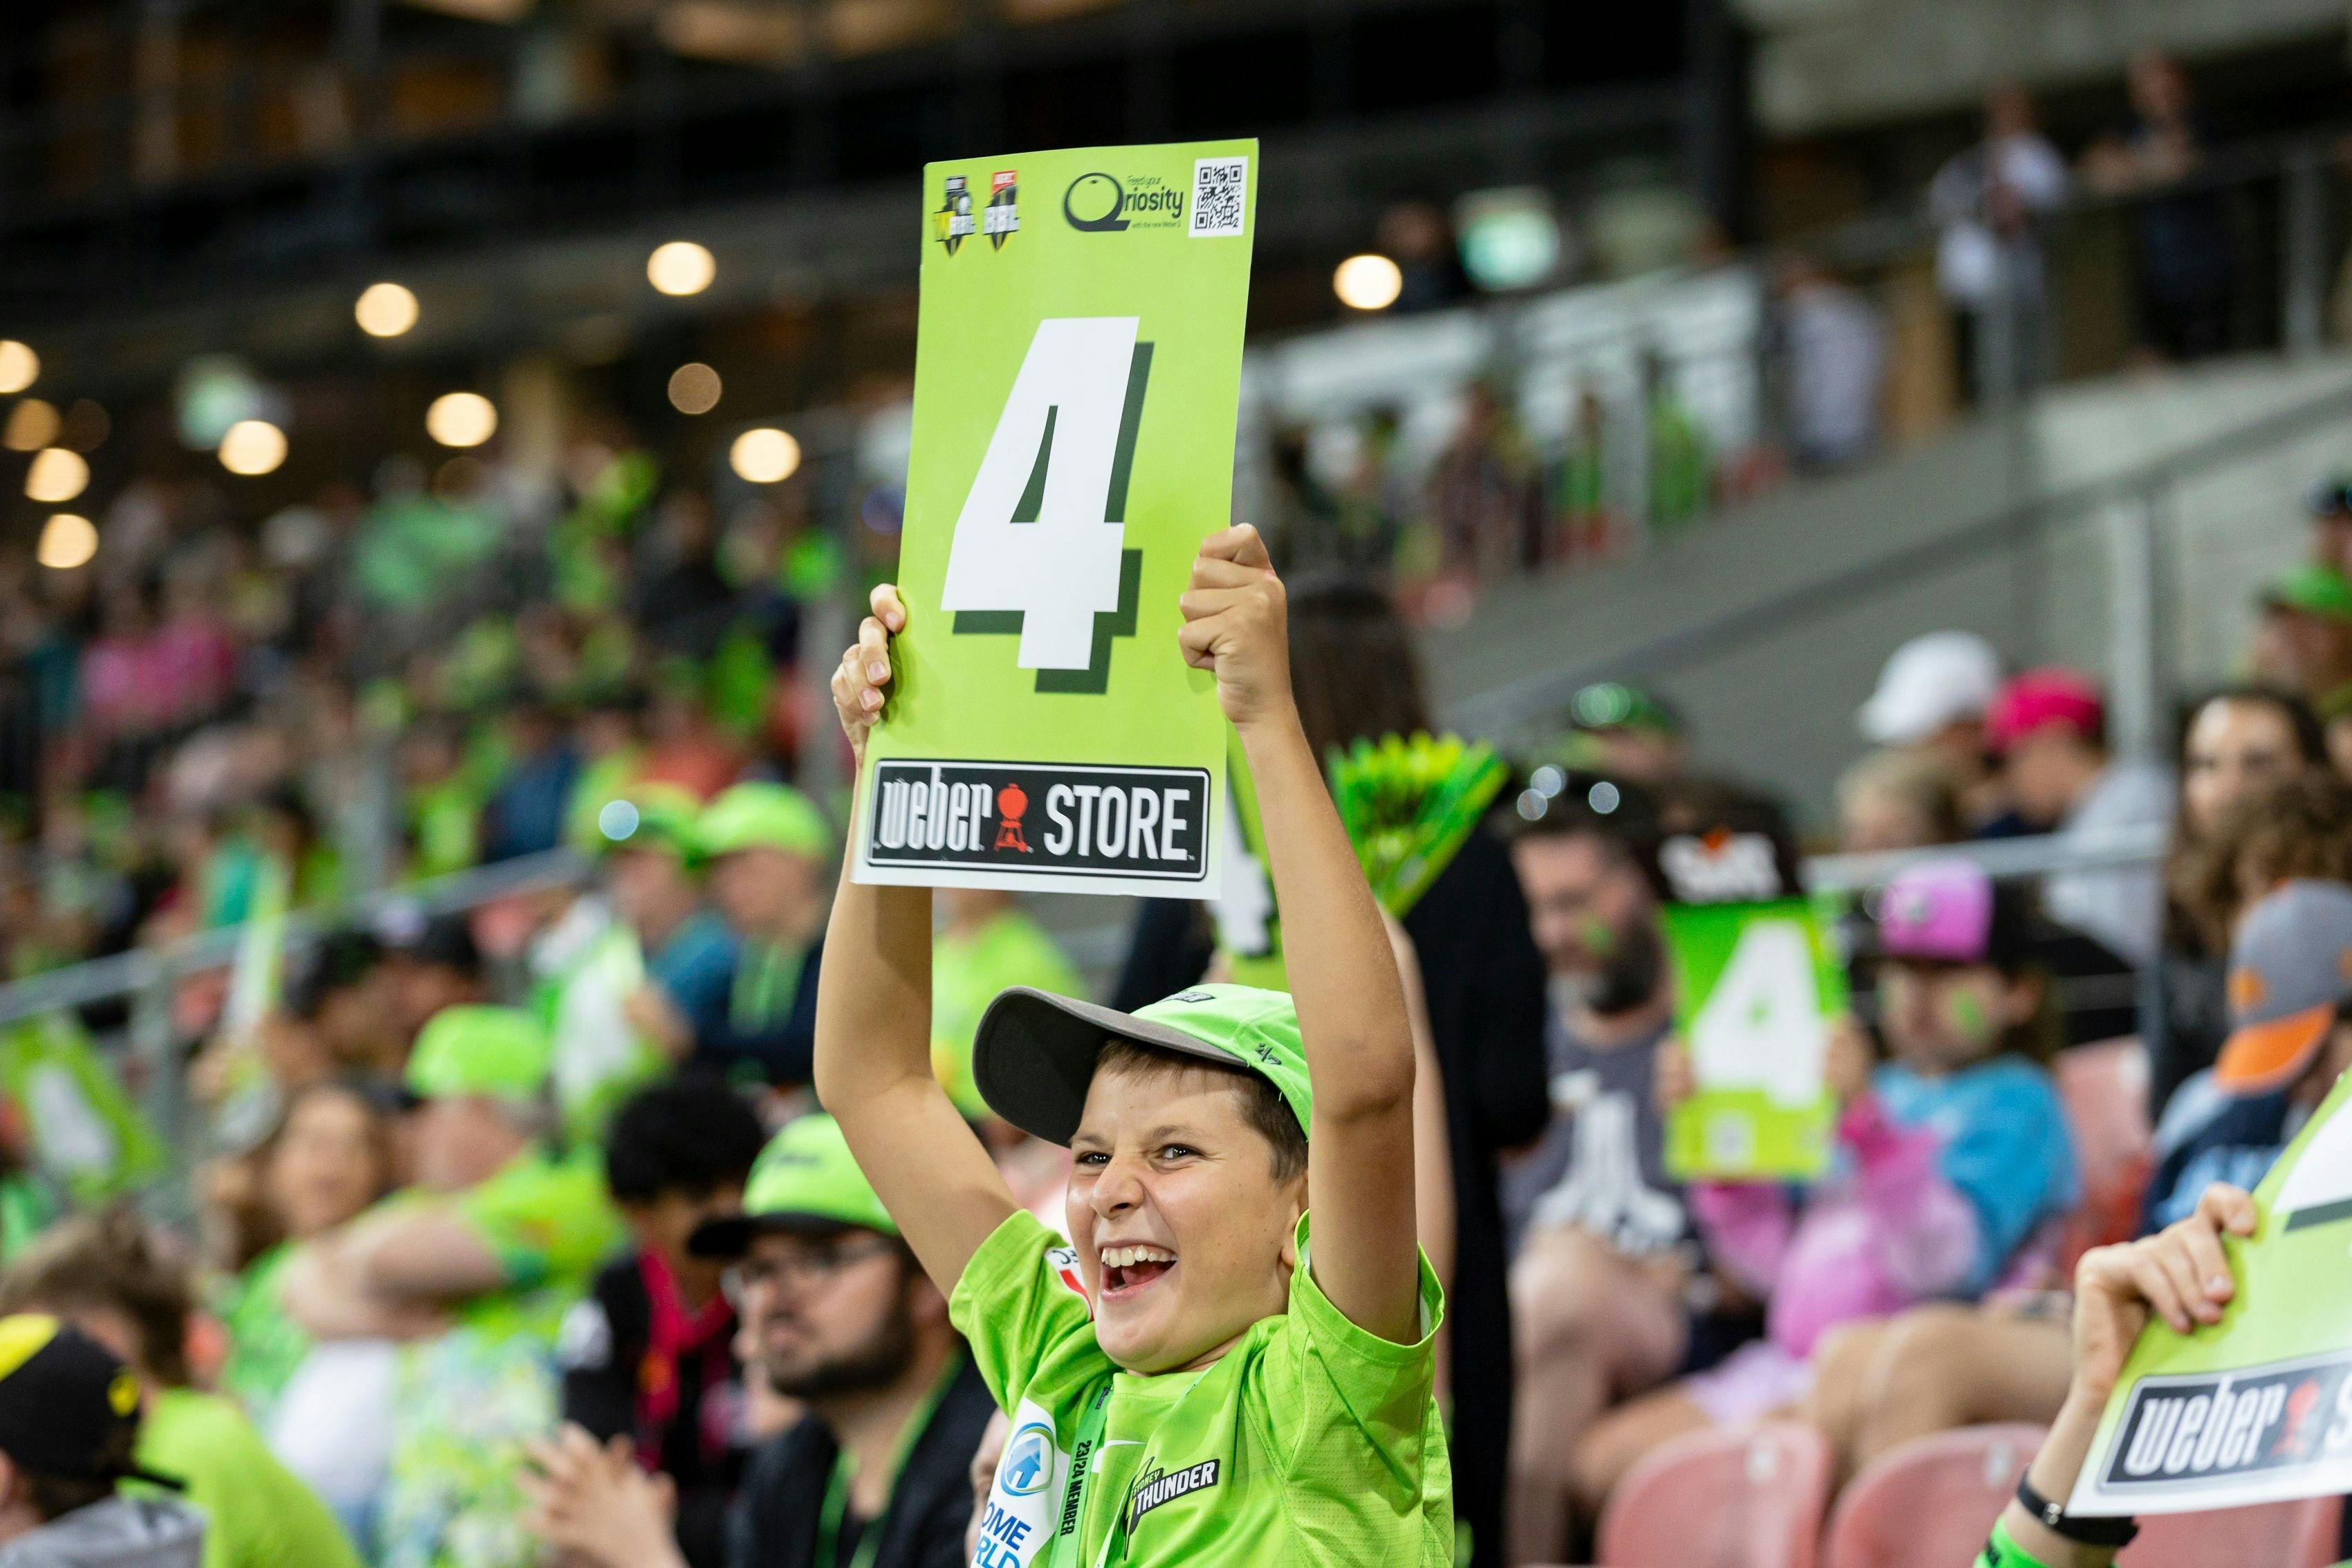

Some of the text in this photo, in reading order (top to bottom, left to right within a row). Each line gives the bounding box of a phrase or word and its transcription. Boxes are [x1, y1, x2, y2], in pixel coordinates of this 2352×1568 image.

[940, 315, 1140, 670] 4
[879, 766, 1191, 861] weber STORE
[1690, 916, 1826, 1110] 4
[2123, 1376, 2287, 1475] weber
[1060, 1439, 1092, 1537] 23/24 MEMBER
[1133, 1470, 1160, 1497] SYDNEY
[1137, 1461, 1215, 1515] THUNDER
